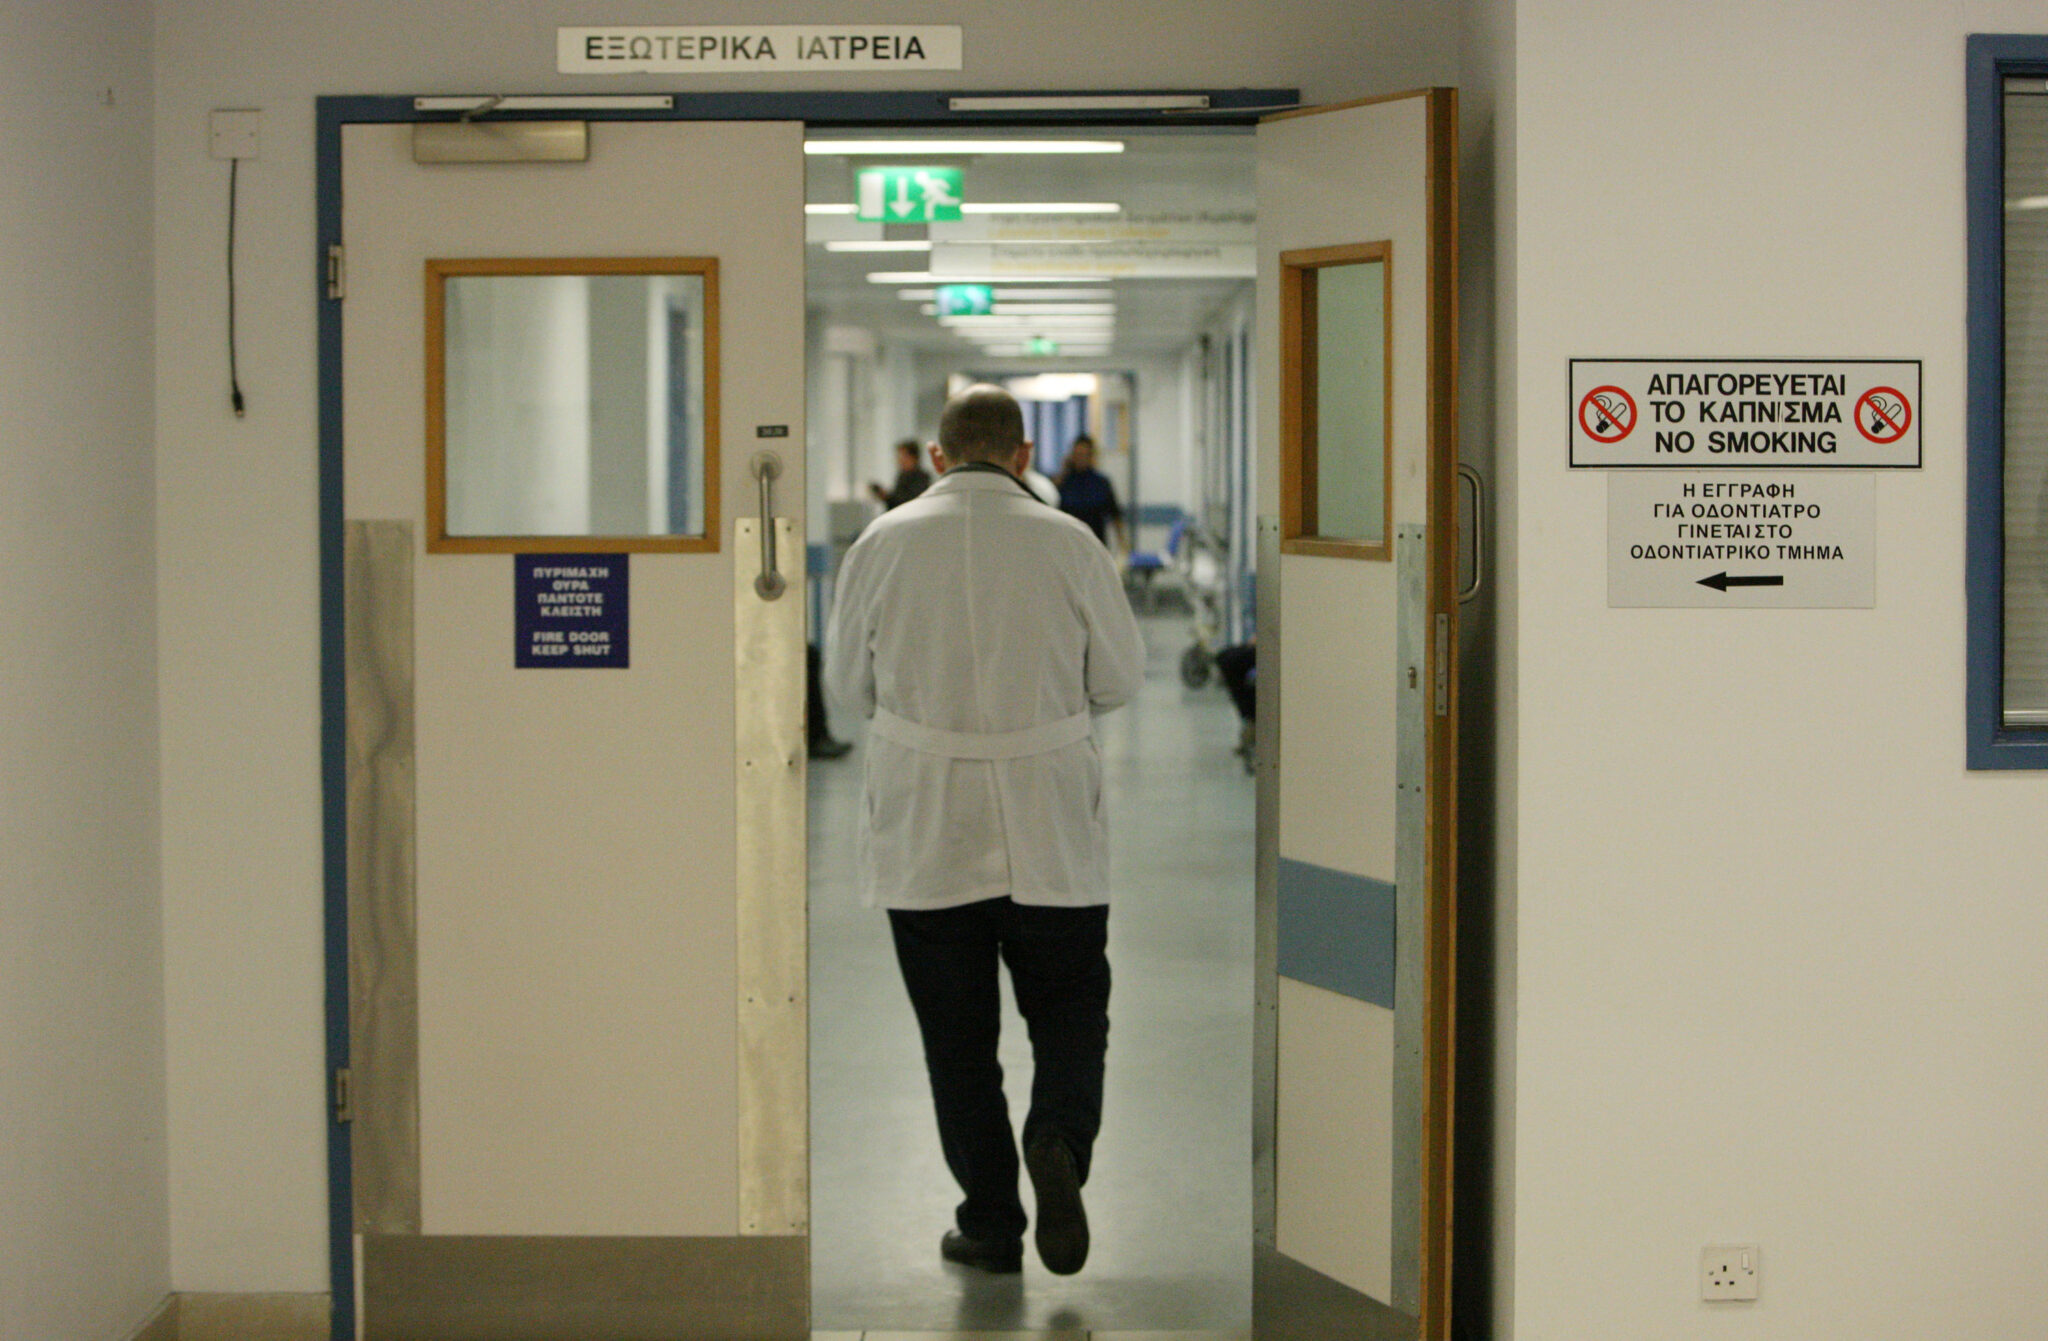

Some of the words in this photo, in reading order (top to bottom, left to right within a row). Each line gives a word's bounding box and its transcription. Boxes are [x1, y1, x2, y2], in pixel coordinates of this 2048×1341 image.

[585, 36, 777, 60] ΕΞΩΤΕΡΙΚΑ
[797, 35, 926, 60] ΙΑΤΡΕΙΑ
[1647, 374, 1846, 396] ΑΠΑΓΟΡΕΥΕΤΑΙ
[1650, 401, 1686, 423] ΤΟ
[1699, 401, 1842, 423] ΚΑΠΝΙΣΜΑ
[1655, 430, 1695, 454] NO
[1707, 430, 1837, 454] SMOKING
[1683, 483, 1695, 498] Η
[1703, 483, 1795, 498] ΕΓΓΡΑΦΗ
[1654, 503, 1685, 518] ΓΙΑ
[1691, 503, 1821, 519] ΟΔΟΝΤΙΑΤΡΟ
[1630, 544, 1770, 560] ΟΔΟΝΤΙΑΤΡΙΚΟ
[1776, 545, 1844, 560] ΤΜΗΜΑ
[533, 567, 609, 578] ΠΥΡΙΜΑΧΗ
[537, 592, 604, 604] ΠΑΝΤΟΤΕ
[533, 631, 564, 643] FIRE
[568, 631, 610, 643] DOOR
[531, 644, 569, 656] KEEP
[572, 644, 611, 656] SHUT
